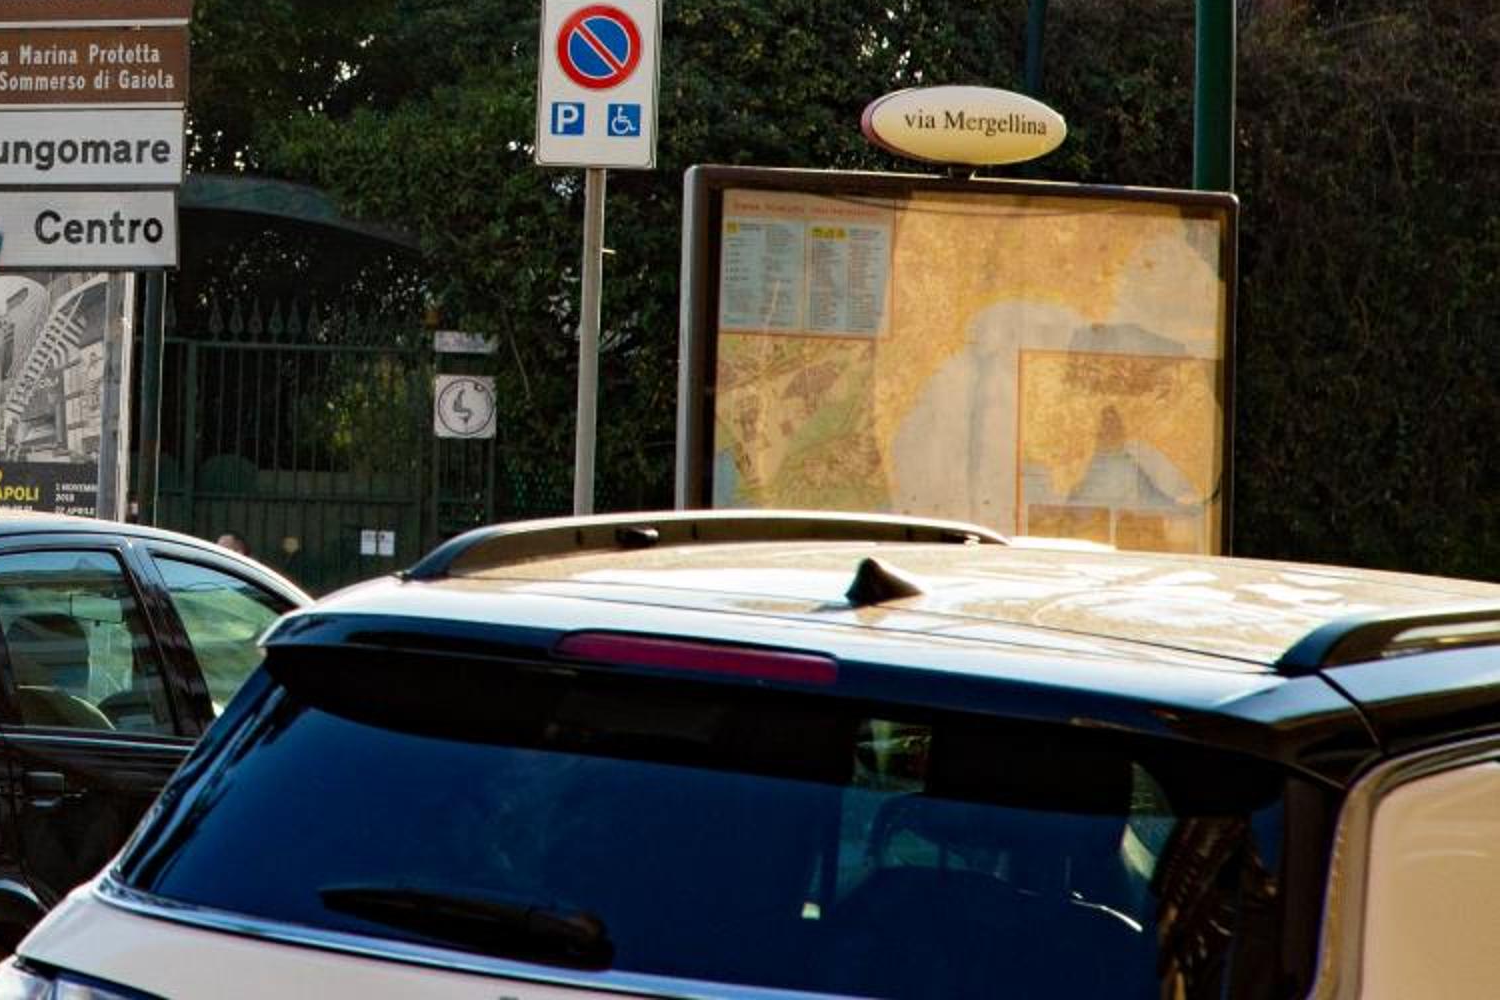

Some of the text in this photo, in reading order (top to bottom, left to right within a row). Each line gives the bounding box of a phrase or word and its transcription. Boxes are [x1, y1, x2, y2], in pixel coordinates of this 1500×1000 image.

[19, 43, 78, 66] Marina
[89, 41, 161, 65] Protetta
[0, 72, 85, 92] Sommerso
[93, 71, 110, 90] di
[118, 71, 175, 90] Gaiola
[557, 104, 579, 132] P
[905, 108, 1047, 137] via Mergellina
[34, 209, 164, 245] Centro
